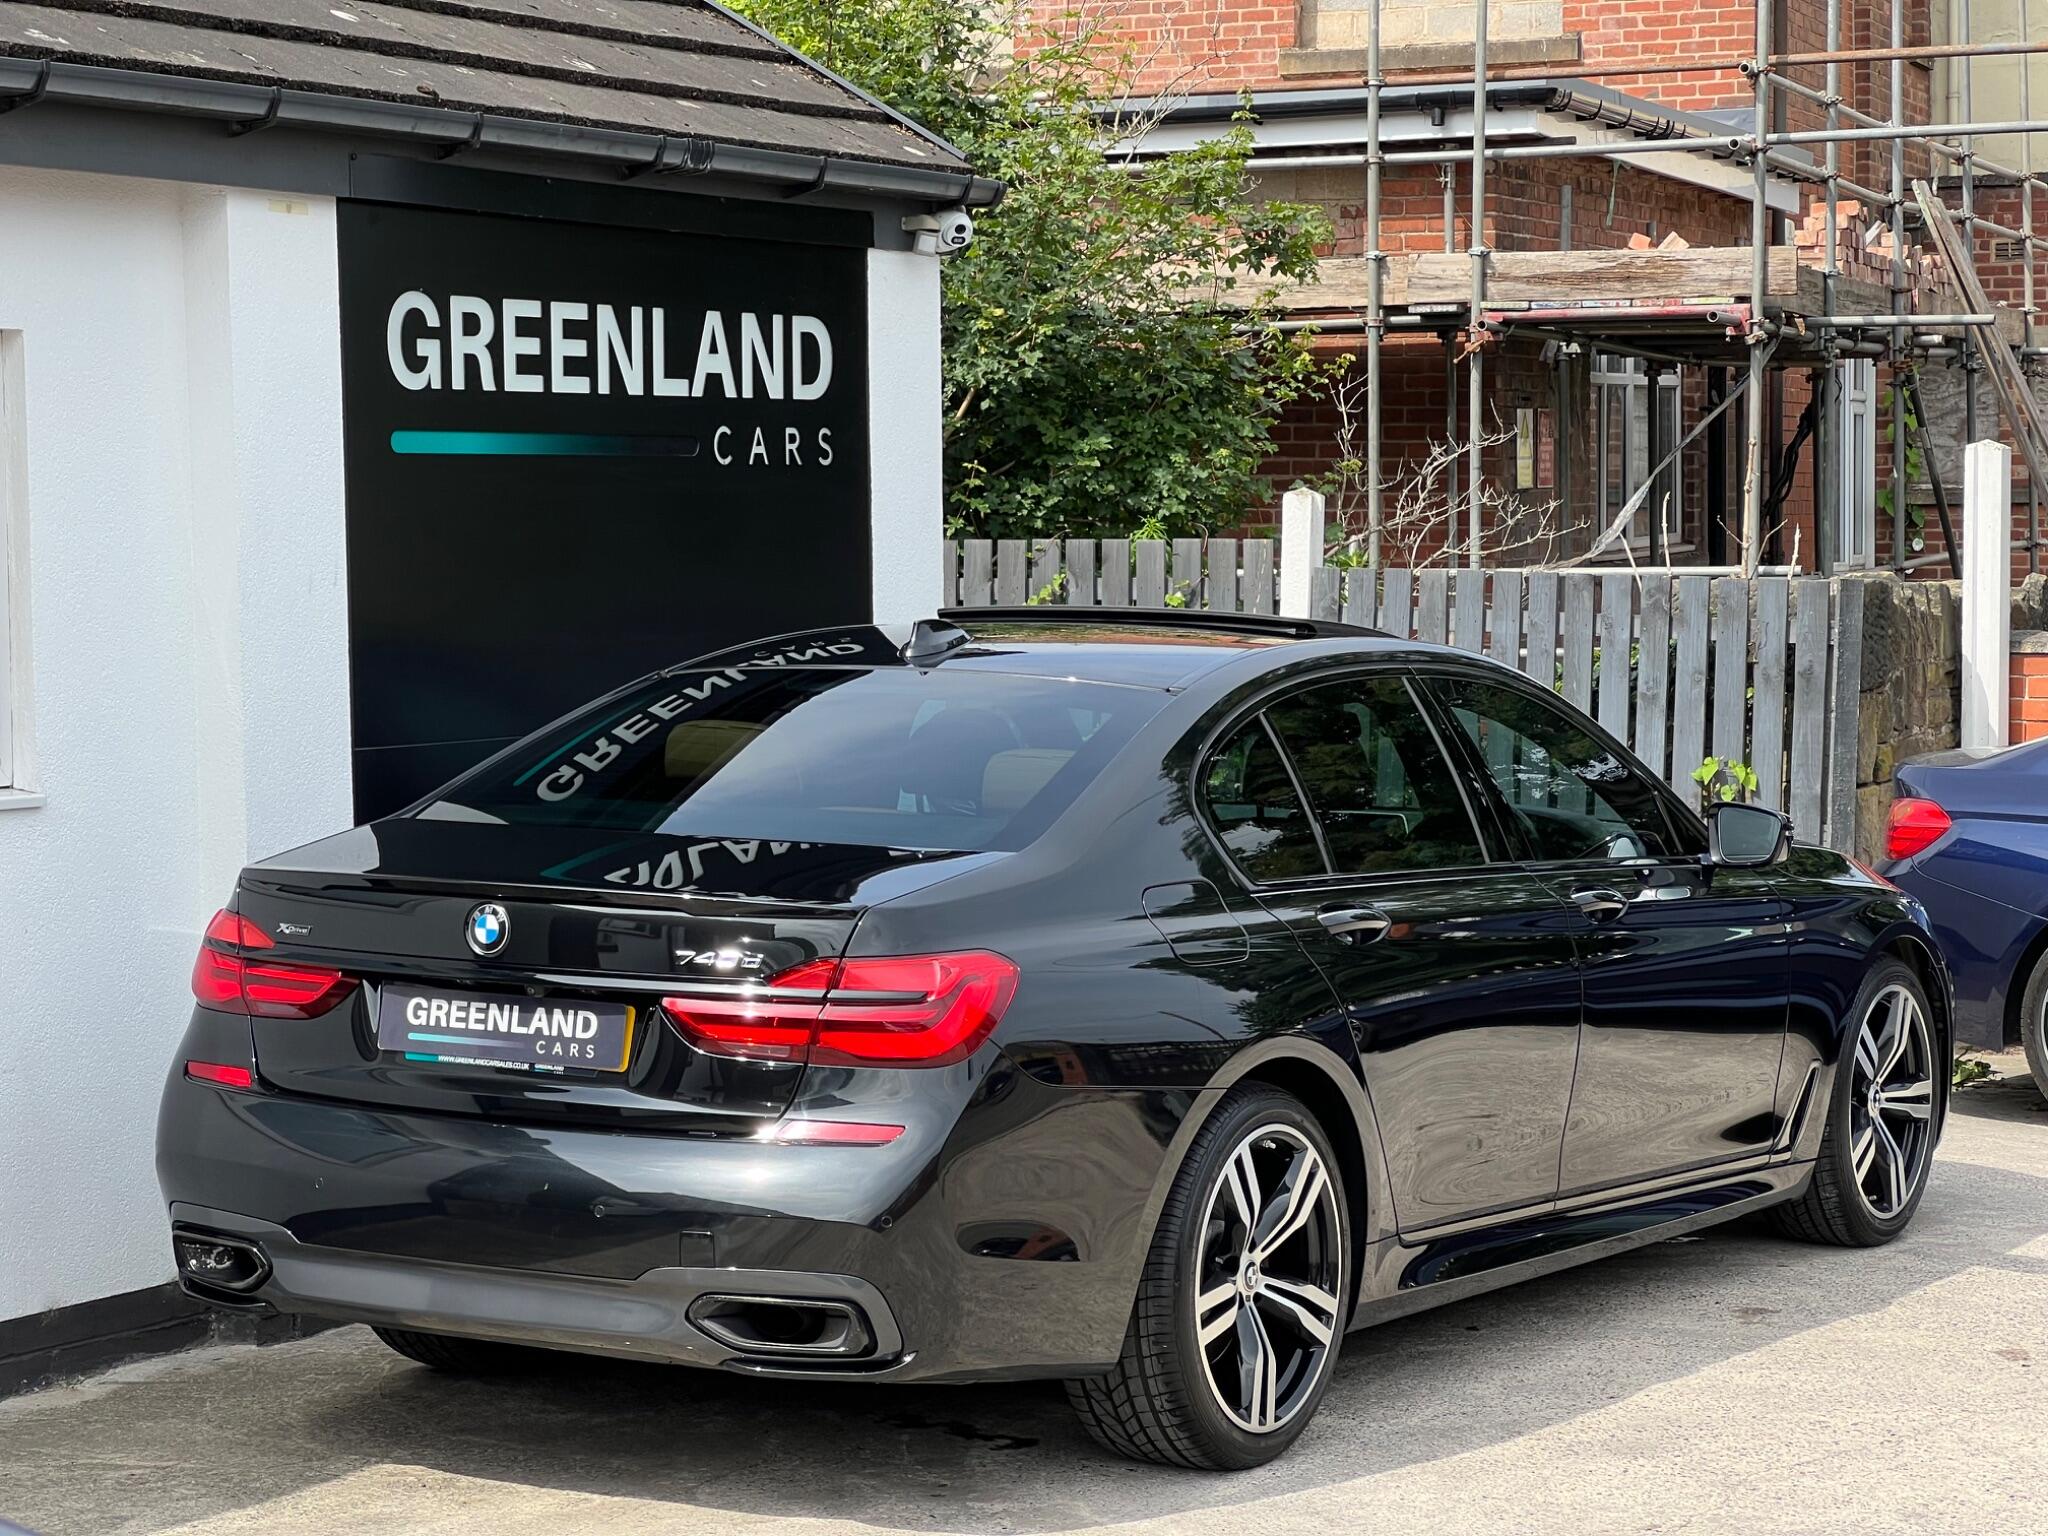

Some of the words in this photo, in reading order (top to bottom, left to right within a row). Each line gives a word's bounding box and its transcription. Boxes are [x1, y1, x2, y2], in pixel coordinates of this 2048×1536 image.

[387, 290, 834, 401] GREENLAND
[714, 426, 835, 466] CARS
[406, 996, 599, 1039] GREENLAND
[536, 1040, 595, 1059] CARS
